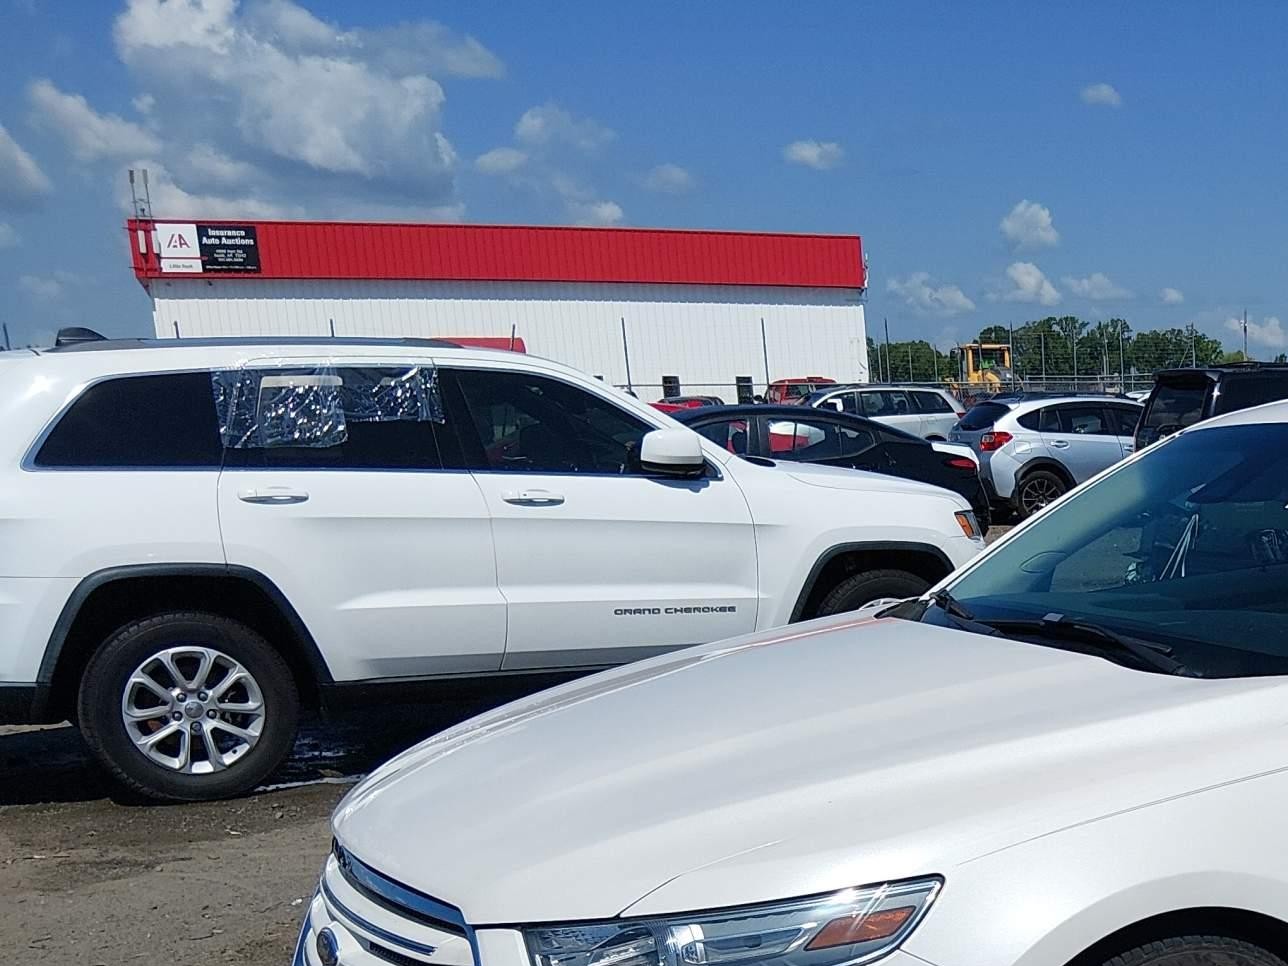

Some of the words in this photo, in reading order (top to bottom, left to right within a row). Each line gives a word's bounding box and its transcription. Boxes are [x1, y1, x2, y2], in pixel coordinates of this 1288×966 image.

[208, 228, 245, 236] Insurance
[202, 236, 220, 245] Auto
[221, 236, 254, 245] Auctions
[613, 608, 662, 616] GRAND
[664, 606, 736, 614] CHEROKEE
